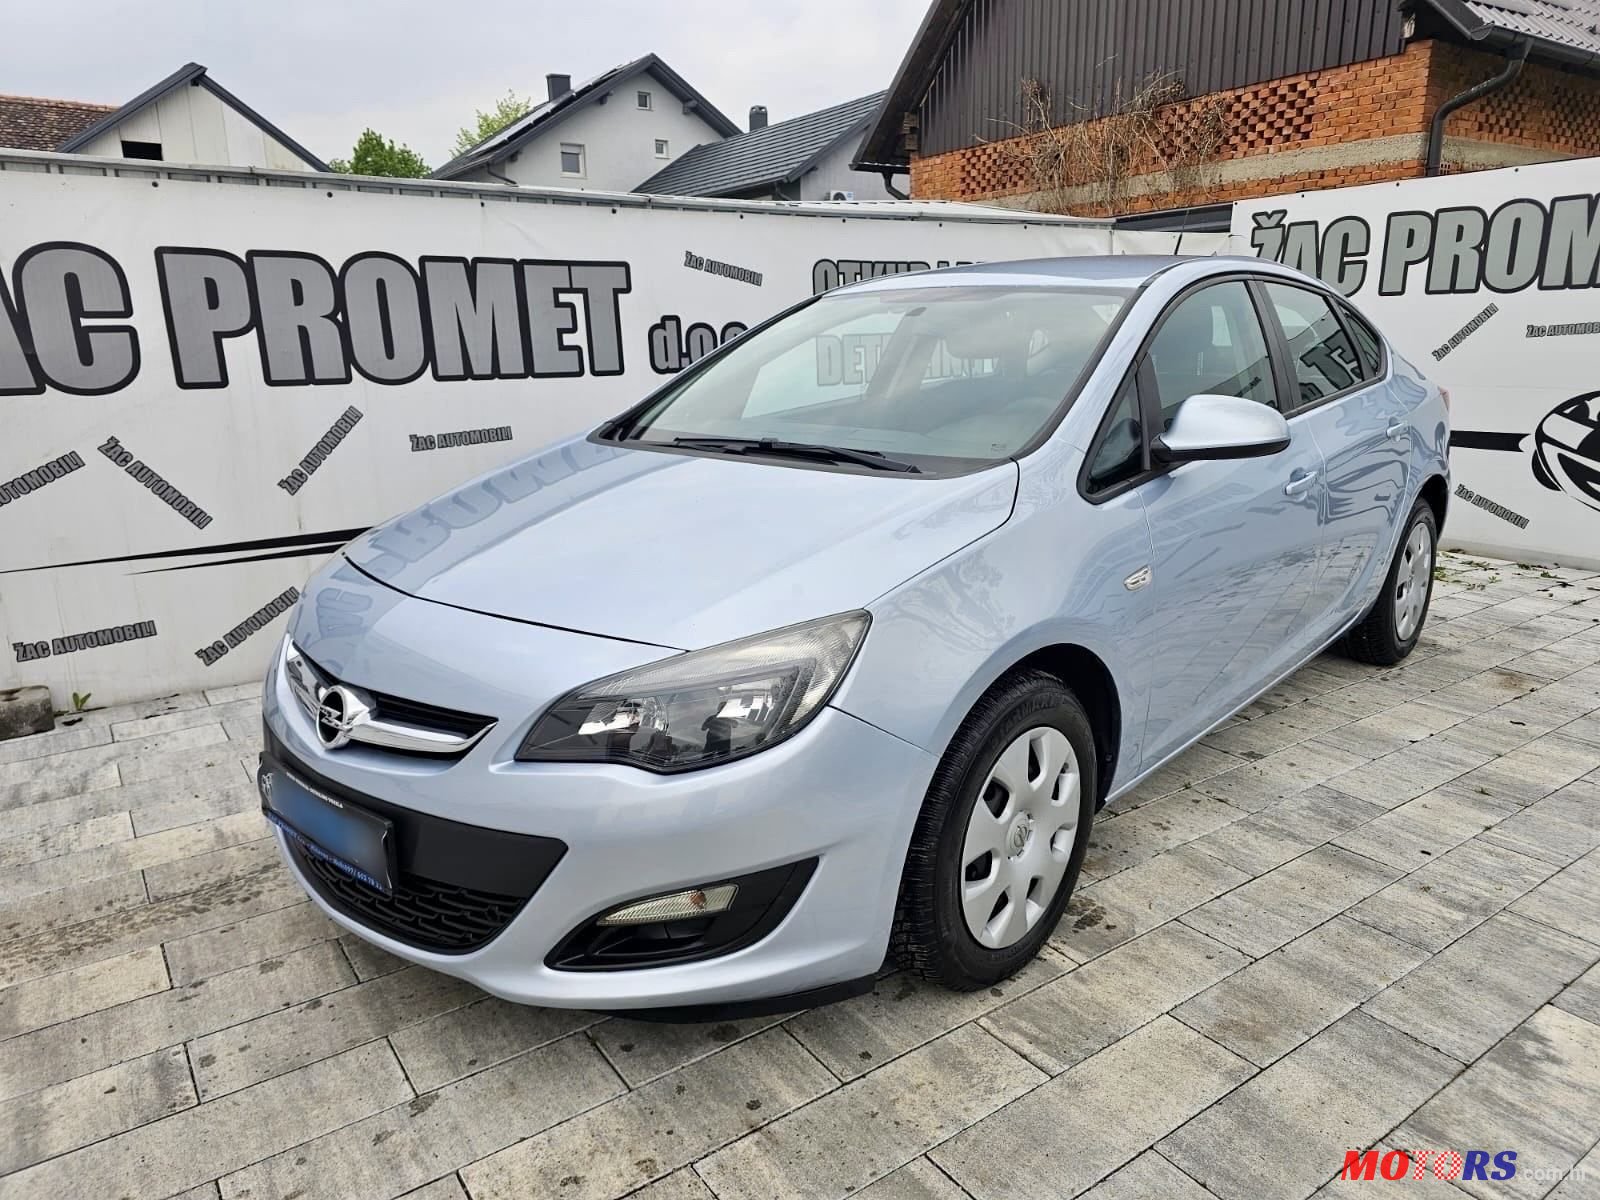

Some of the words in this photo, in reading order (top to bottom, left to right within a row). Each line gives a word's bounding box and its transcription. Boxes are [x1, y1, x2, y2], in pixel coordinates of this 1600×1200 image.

[703, 258, 763, 287] AUTOMOBILI
[1251, 209, 1370, 298] ŽAC
[154, 246, 632, 390] PROMET
[1447, 302, 1499, 349] AUTOMOBILI
[277, 467, 309, 496] ŽAC
[299, 405, 364, 476] AUTOMOBILI
[409, 434, 437, 452] ŽAC
[437, 426, 513, 449] AUTOMOBILI
[0, 450, 86, 508] UTOMOBILI
[97, 435, 134, 467] ŽAC
[124, 460, 214, 530] AUTOMOBILI
[1470, 494, 1530, 530] AUTOMOBILI
[12, 641, 52, 663] ŽAC
[52, 619, 158, 656] AUTOMOBILI
[195, 639, 229, 667] ŽAC
[223, 586, 300, 649] AUTOMOBILI
